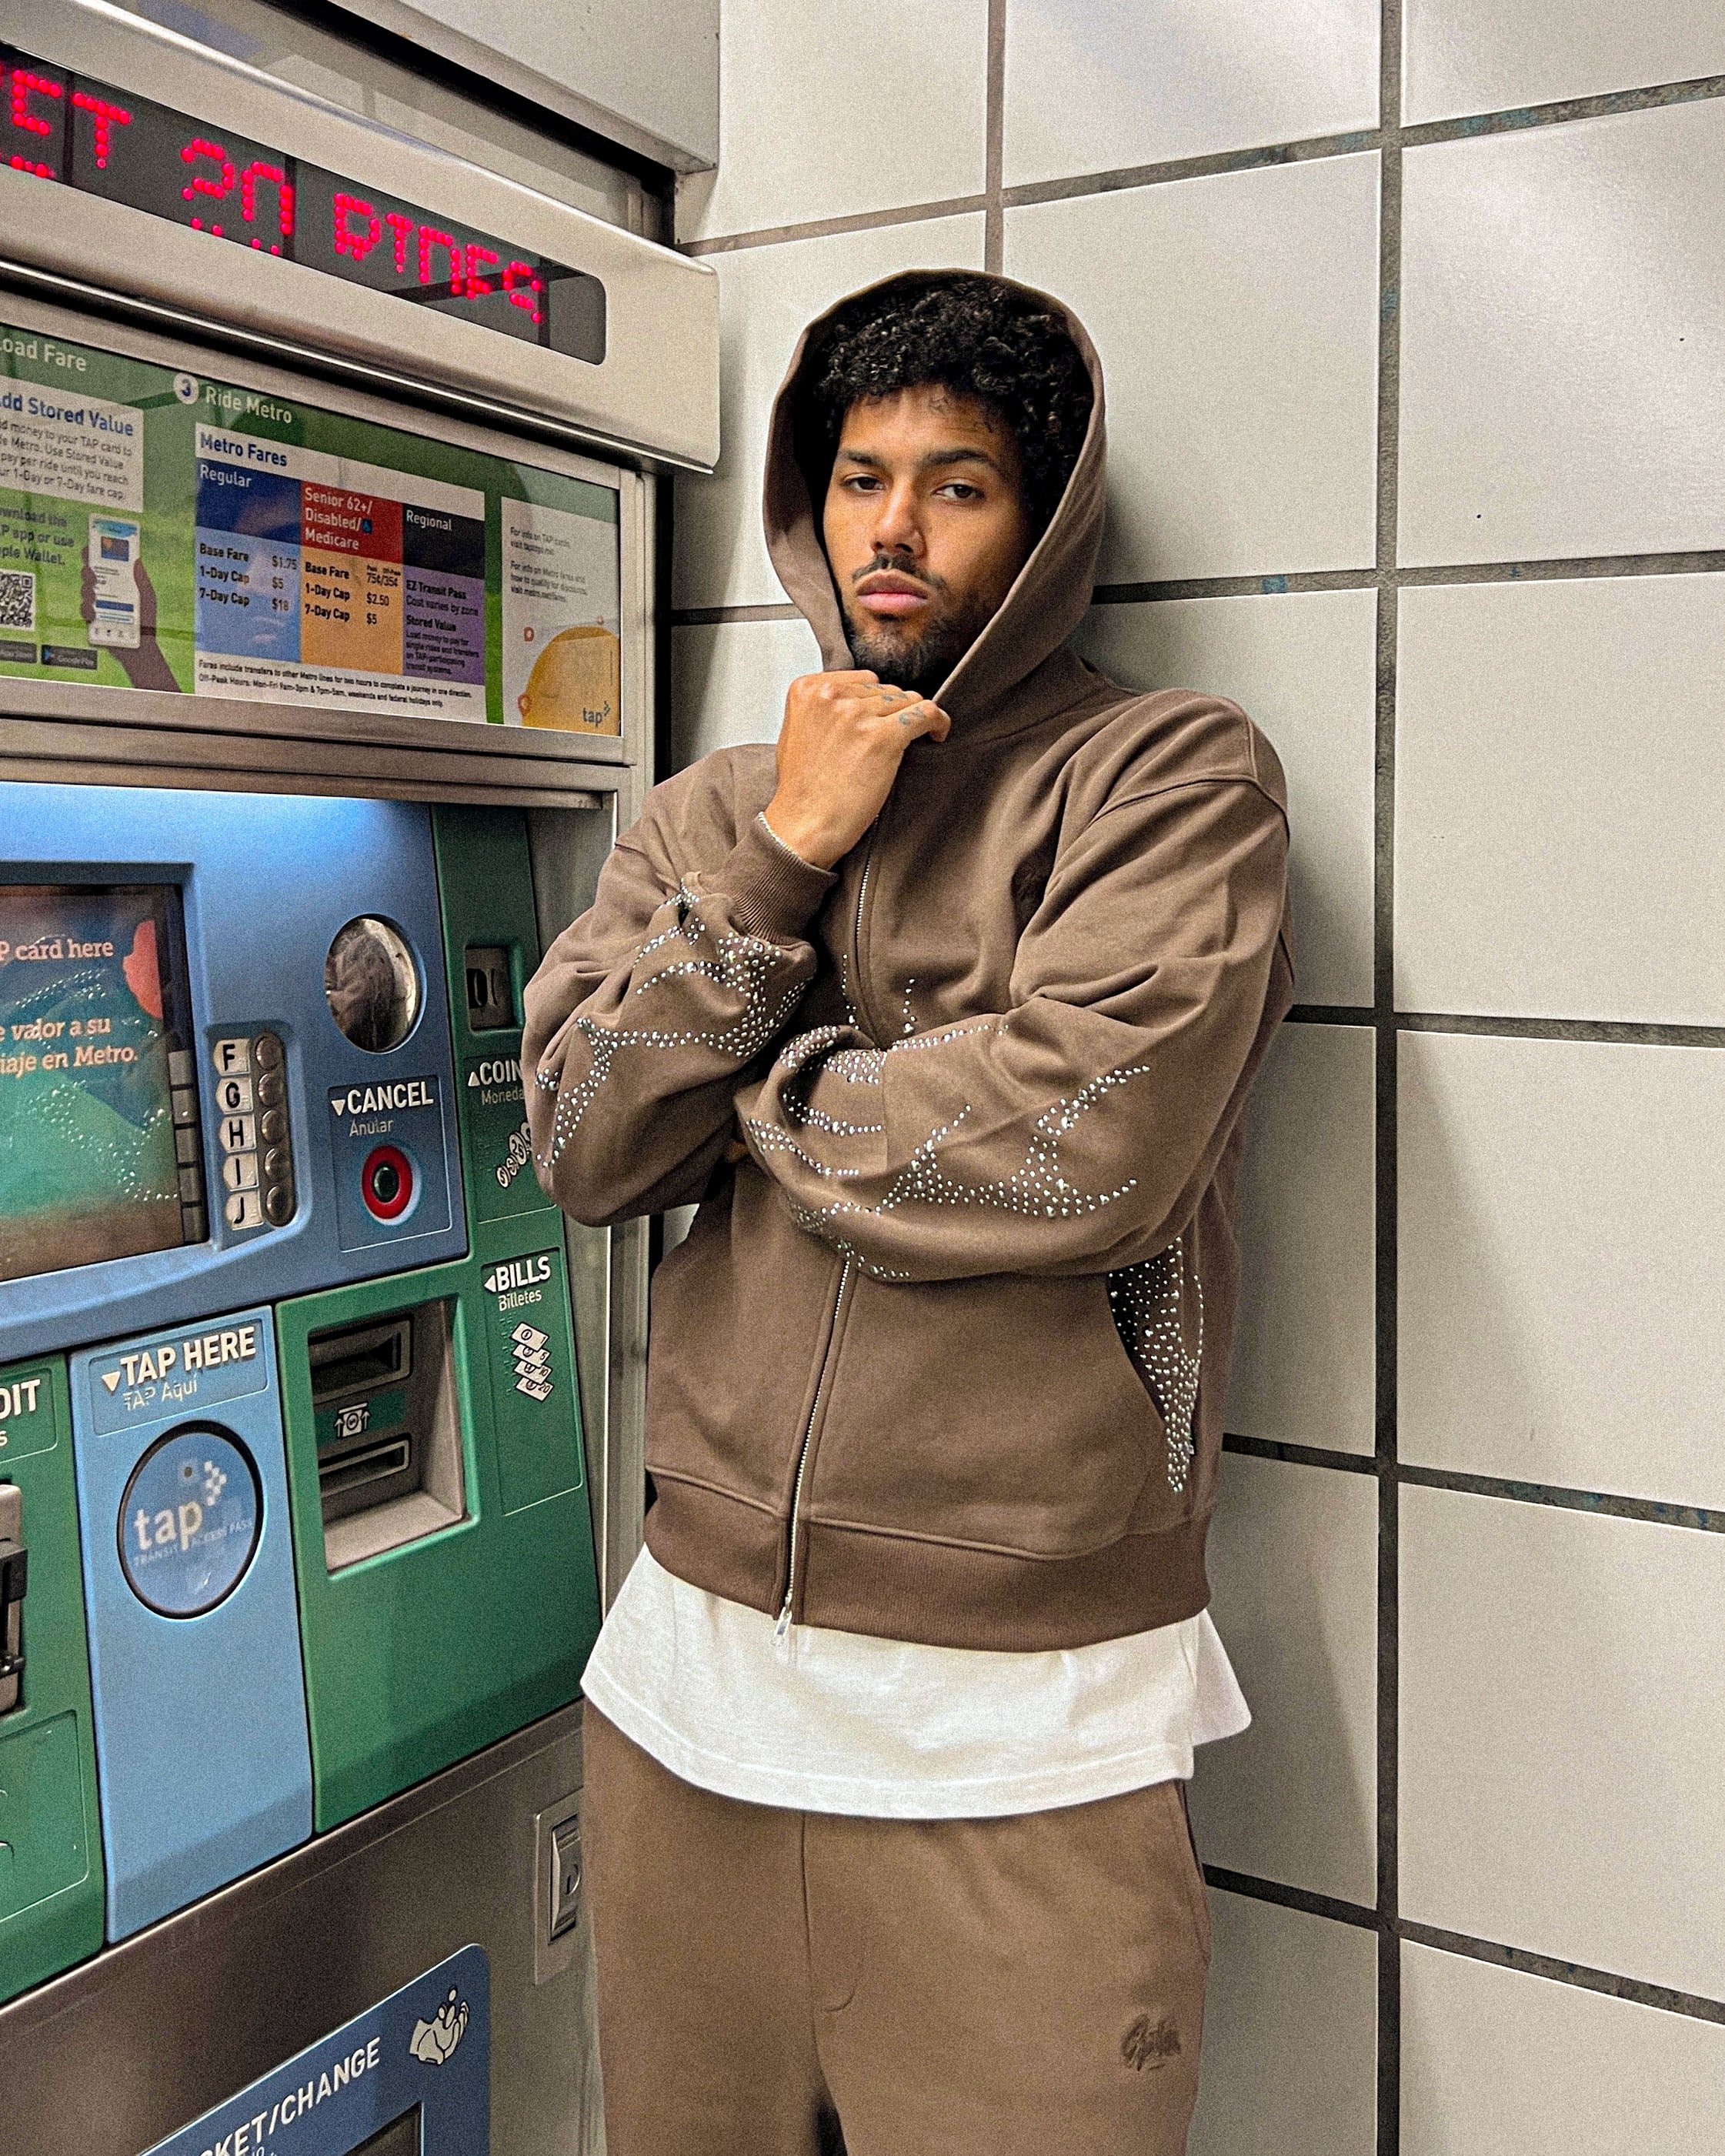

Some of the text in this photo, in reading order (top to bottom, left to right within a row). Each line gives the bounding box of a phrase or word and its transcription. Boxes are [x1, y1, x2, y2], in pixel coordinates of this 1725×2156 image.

[0, 339, 87, 372] oad Fare
[0, 392, 133, 436] dd Stored Value
[206, 385, 242, 411] Ride
[246, 396, 292, 423] Metro
[45, 443, 63, 457] Use
[81, 436, 99, 449] TAP
[201, 432, 287, 466] Metro Fares
[200, 464, 252, 487] Regular
[305, 487, 343, 508] Senior
[305, 507, 362, 531] Disabled/
[406, 509, 452, 531] Regional
[305, 527, 359, 550] Medicare
[200, 542, 297, 570] Base Fare $1.75
[200, 566, 284, 589] 1-Day Cap $5
[305, 562, 327, 575] Base
[329, 566, 349, 579] Fare
[200, 587, 289, 611] 7-Day Cap $18
[305, 582, 389, 606] 1-Day Cap $2.50
[305, 603, 377, 624] 7-Day Cap $5
[582, 707, 602, 727] tap
[15, 939, 64, 961] card
[67, 939, 114, 959] here
[12, 1018, 65, 1040] valor
[69, 1020, 82, 1036] a
[86, 1018, 112, 1035] su
[42, 1053, 68, 1071] en
[73, 1045, 138, 1066] Metro.
[222, 1043, 235, 1071] F
[225, 1081, 241, 1109] G
[347, 1081, 434, 1115] CANCEL
[229, 1120, 244, 1147] H
[349, 1118, 394, 1137] Anular
[235, 1157, 242, 1186] I
[233, 1196, 245, 1224] J
[495, 1256, 551, 1292] BILLS
[499, 1289, 542, 1311] Billetes
[121, 1326, 256, 1387] TAP HERE
[123, 1374, 198, 1411] TAP Aquí
[133, 1501, 202, 1551] tap
[199, 2037, 380, 2156] KET/CHANGE
